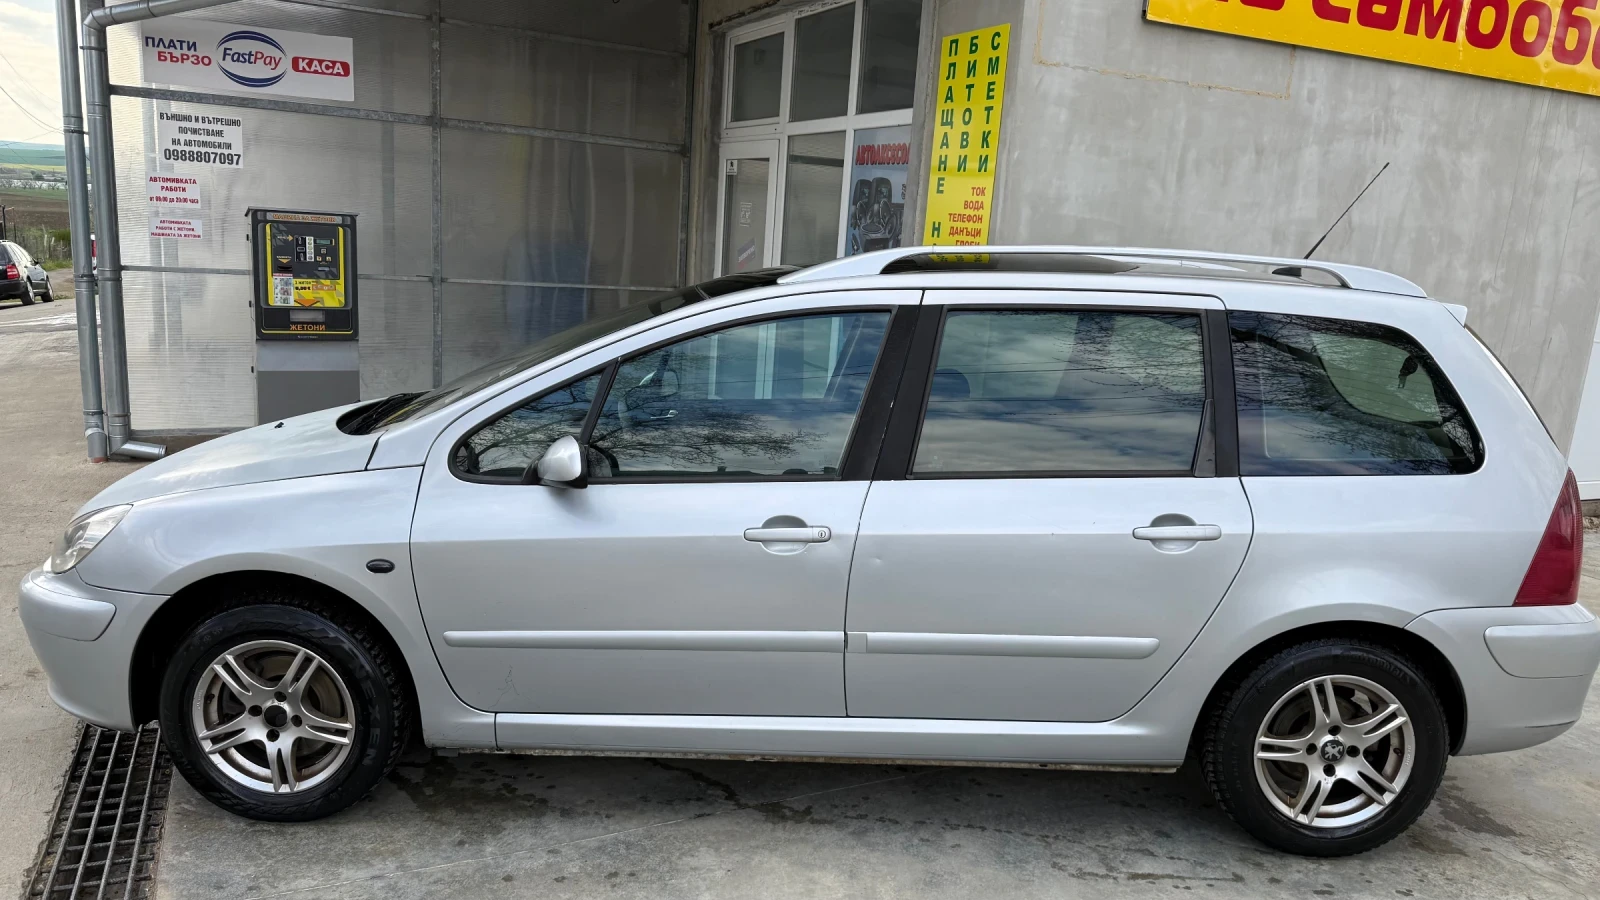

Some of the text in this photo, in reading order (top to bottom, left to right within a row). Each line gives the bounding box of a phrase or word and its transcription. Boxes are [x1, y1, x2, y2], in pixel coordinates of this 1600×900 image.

[145, 36, 197, 52] ПЛАТИ
[157, 50, 212, 66] БЪРЗО
[222, 47, 282, 70] FastPay
[298, 58, 345, 75] КАСА
[957, 35, 979, 172] БИТОВИ
[978, 31, 1001, 172] СМЕТКИ
[159, 112, 242, 127] ВЪНШНО И ВЪТРЕШНО
[936, 38, 959, 194] ПЛАЩАНЕ
[178, 126, 225, 138] ПОЧИСТВАНЕ
[171, 138, 232, 151] НА АВТОМОБИЛИ
[163, 148, 242, 166] 0988807097
[149, 176, 197, 184] АВТОМИВКАТА
[971, 186, 986, 197] ТОК
[963, 200, 985, 212] ВОДА
[948, 213, 983, 224] ТЕЛЕФОН
[948, 226, 982, 239] ДАНЪЦИ
